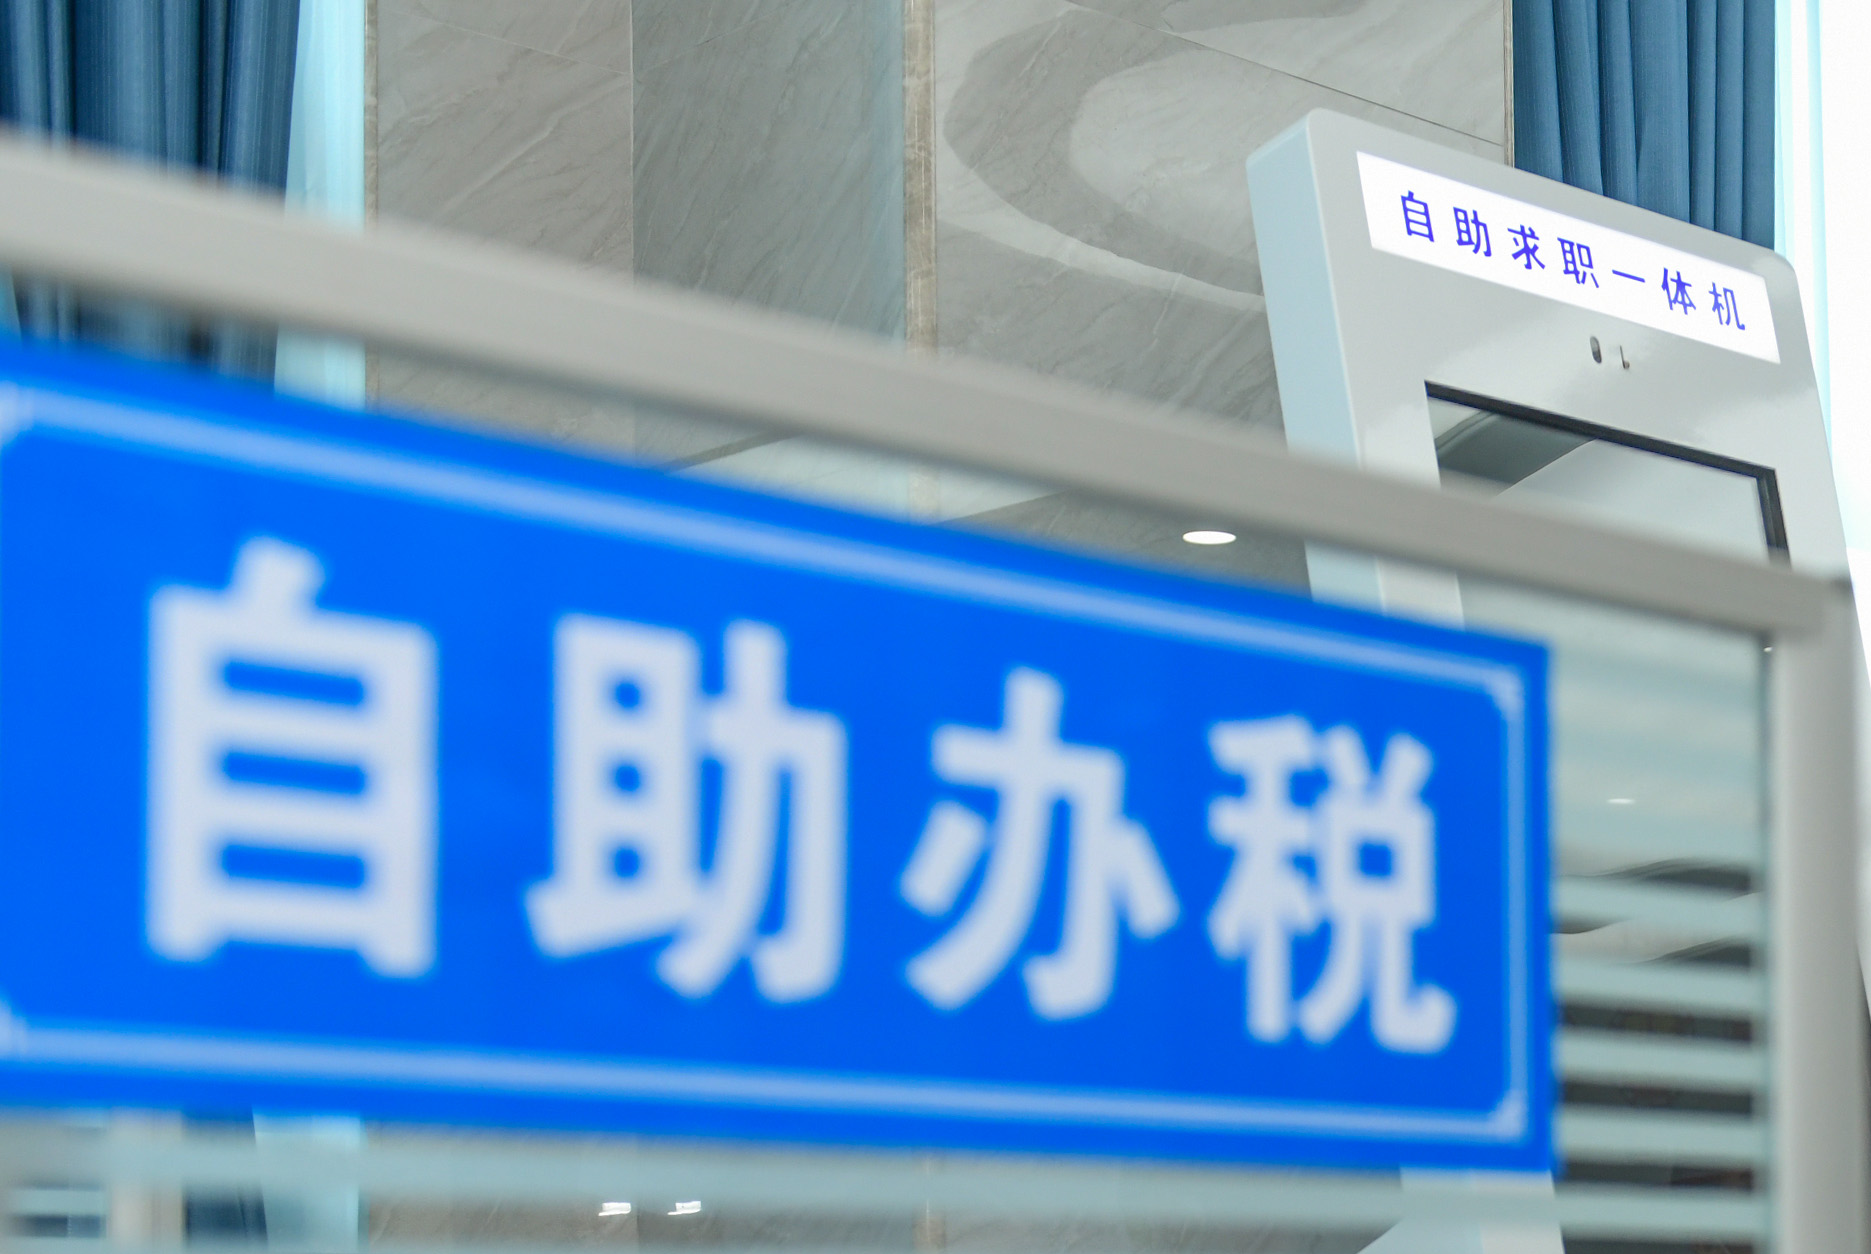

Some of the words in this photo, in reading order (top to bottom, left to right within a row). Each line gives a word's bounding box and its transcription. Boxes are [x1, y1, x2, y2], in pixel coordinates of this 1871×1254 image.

[1401, 190, 1746, 331] 自助求职一体机
[144, 537, 1460, 1052] 自助办税
